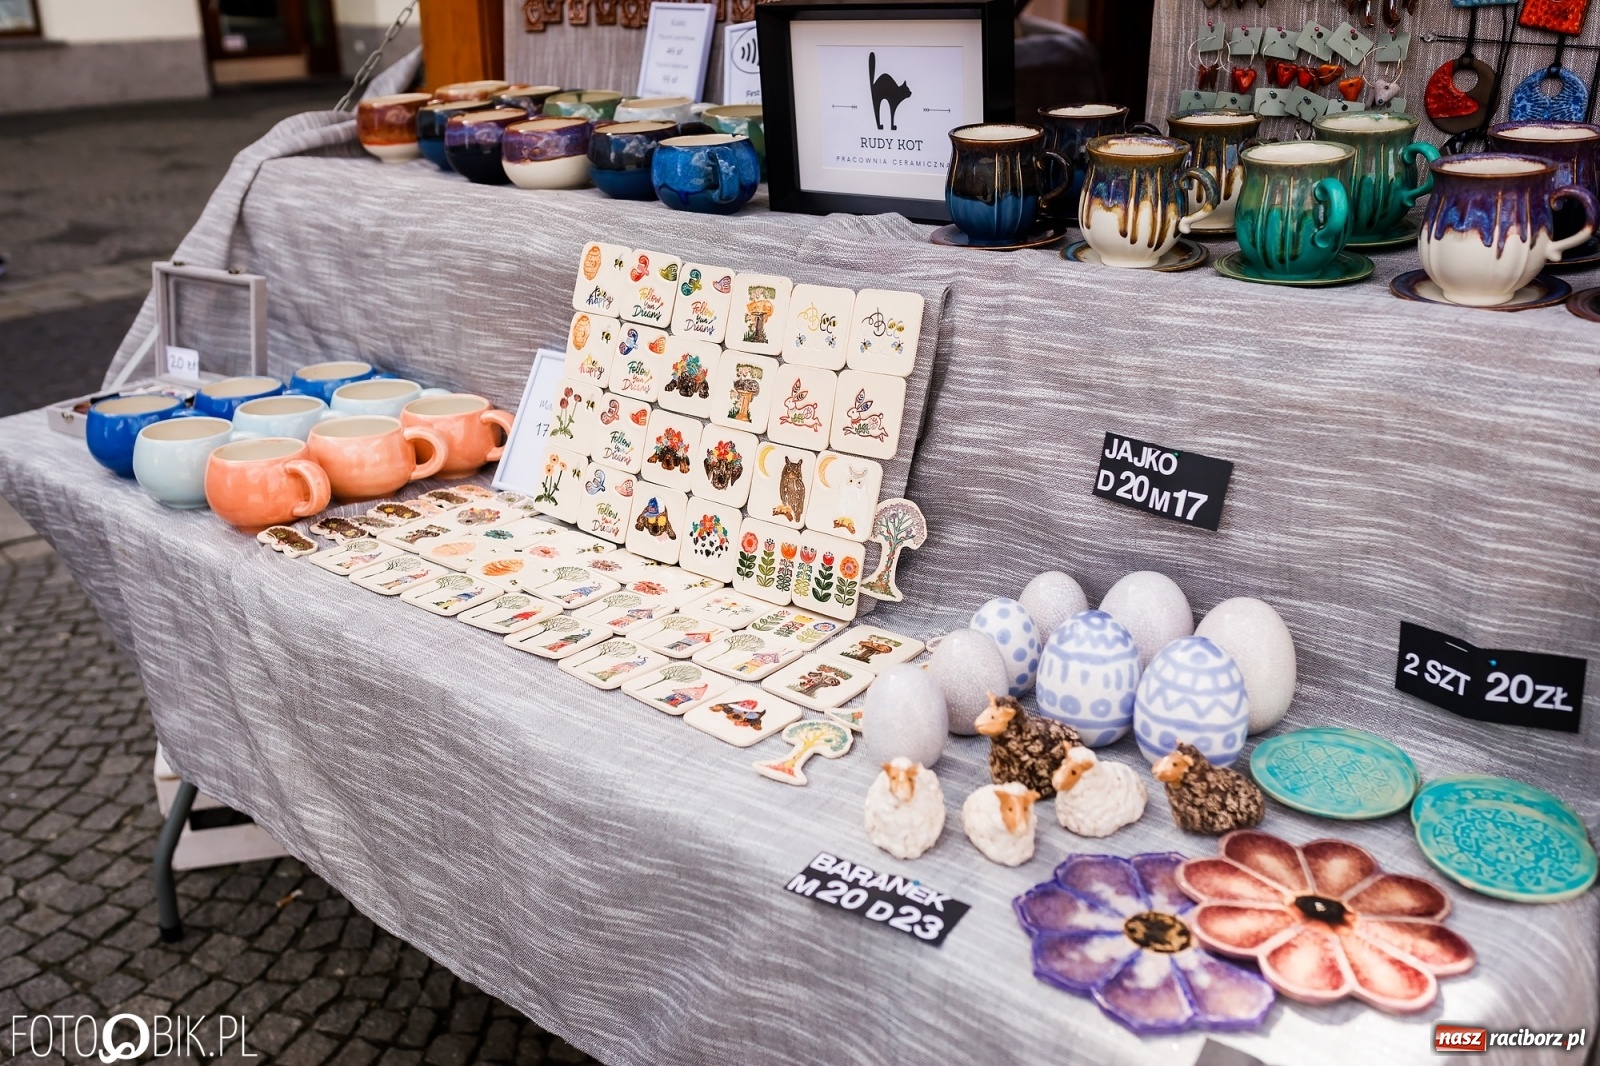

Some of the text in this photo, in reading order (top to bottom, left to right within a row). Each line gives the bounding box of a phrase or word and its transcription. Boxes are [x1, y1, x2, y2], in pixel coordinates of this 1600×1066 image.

[836, 155, 951, 168] PRACOWNIA CERAMICZNA
[860, 137, 924, 151] RUDY KOT
[536, 422, 550, 437] 17
[1104, 438, 1178, 476] JAJKO
[1096, 469, 1209, 521] D 20 M 17
[1403, 652, 1420, 676] 2
[1423, 659, 1471, 696] SZT
[809, 852, 953, 912] BARANEK
[786, 874, 945, 940] M 20 D 23
